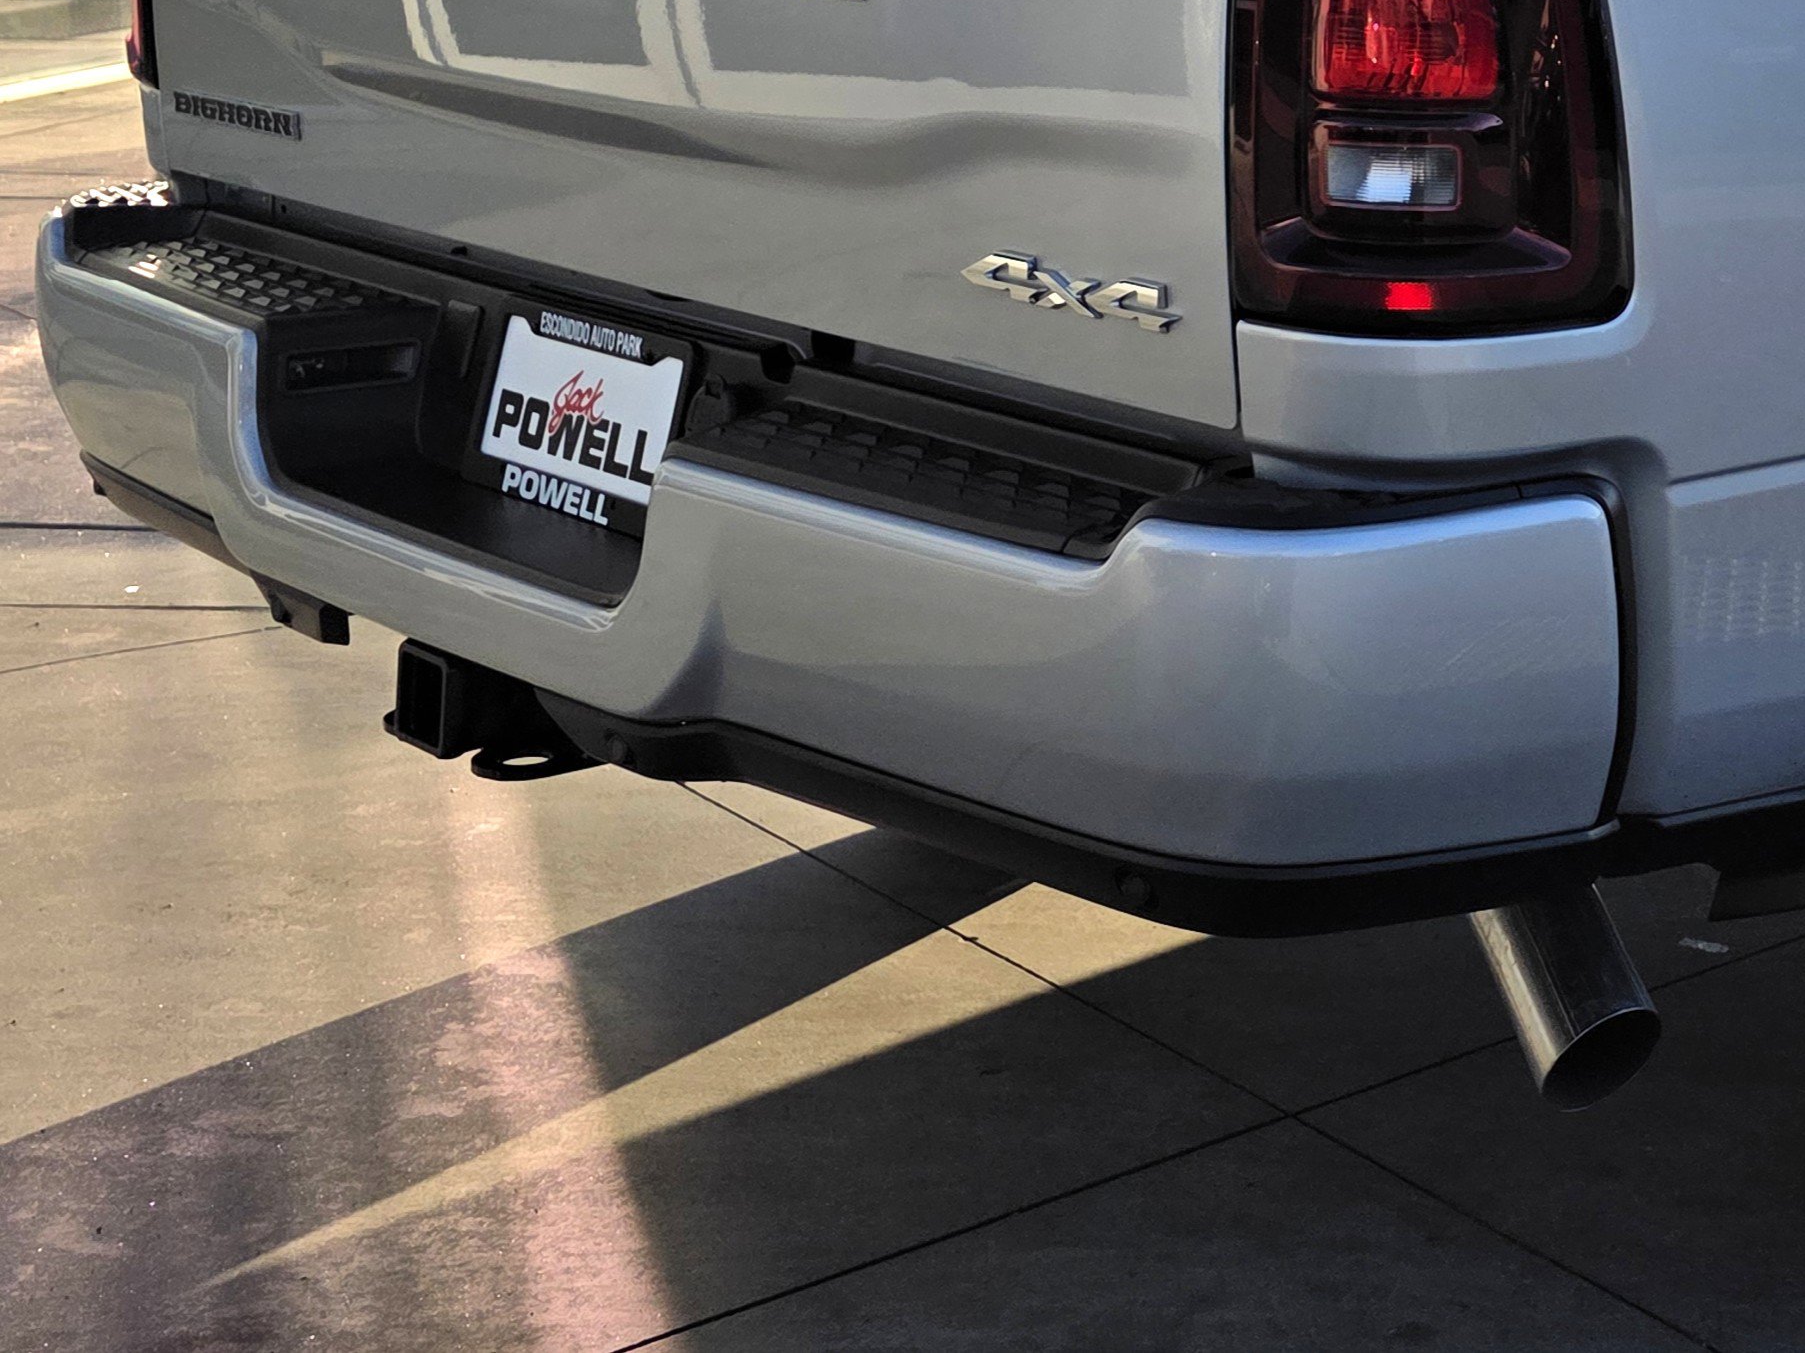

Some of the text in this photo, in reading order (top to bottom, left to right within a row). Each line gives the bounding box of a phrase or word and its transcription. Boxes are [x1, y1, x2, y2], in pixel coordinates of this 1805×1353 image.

[173, 90, 300, 139] BIGHORN
[540, 311, 643, 359] ESCONDIDO AUTO PARK
[548, 370, 605, 434] Jack
[492, 388, 655, 486] POWELL
[502, 463, 609, 526] POWELL
